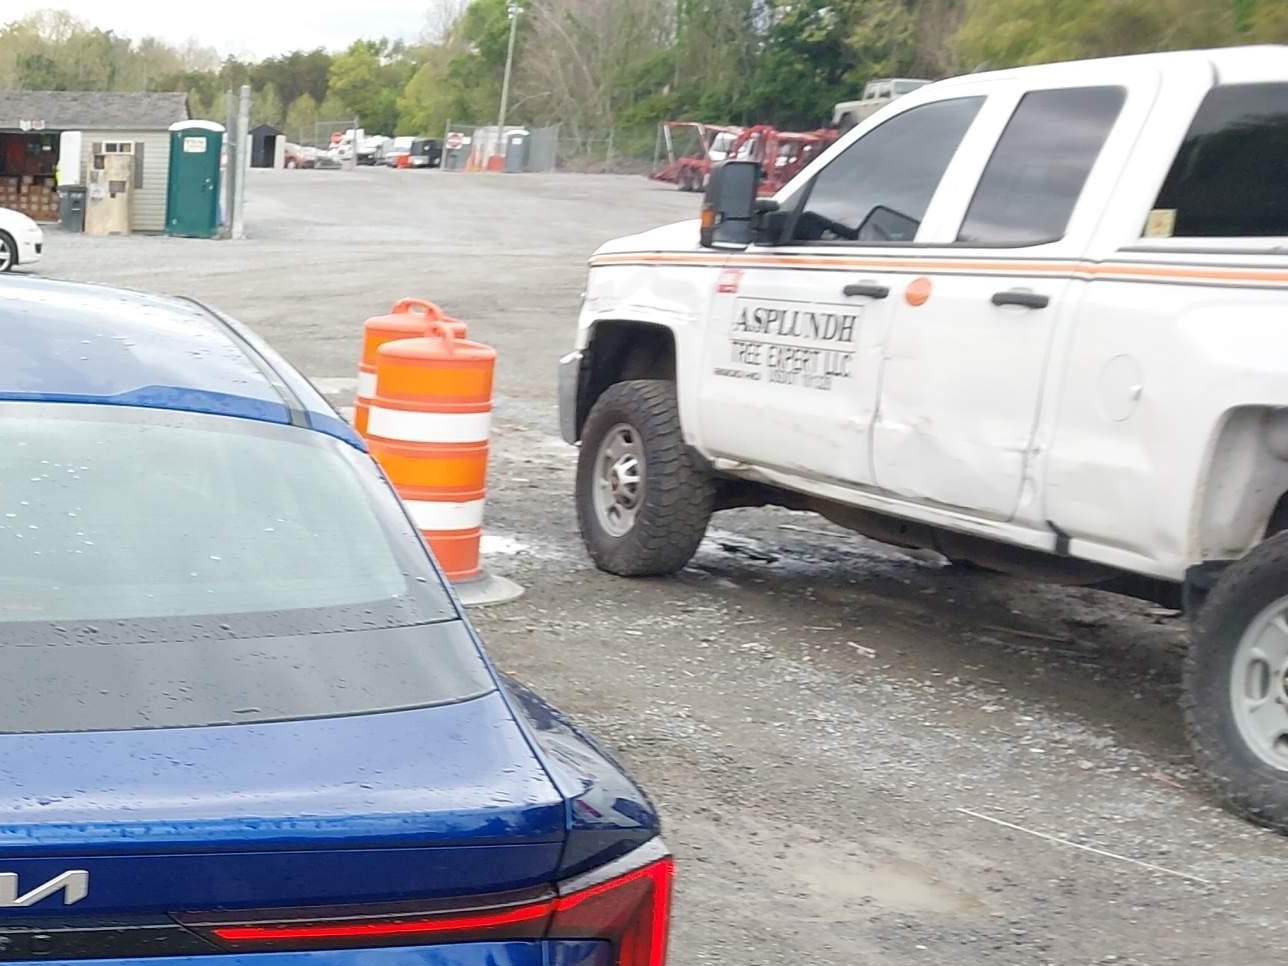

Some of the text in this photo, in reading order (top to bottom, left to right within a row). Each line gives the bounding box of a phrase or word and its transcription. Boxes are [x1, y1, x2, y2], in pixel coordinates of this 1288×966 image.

[732, 306, 857, 342] ASPLUNDH
[732, 341, 761, 365] TREE
[766, 345, 820, 374] EXPERT
[823, 350, 851, 377] LLC
